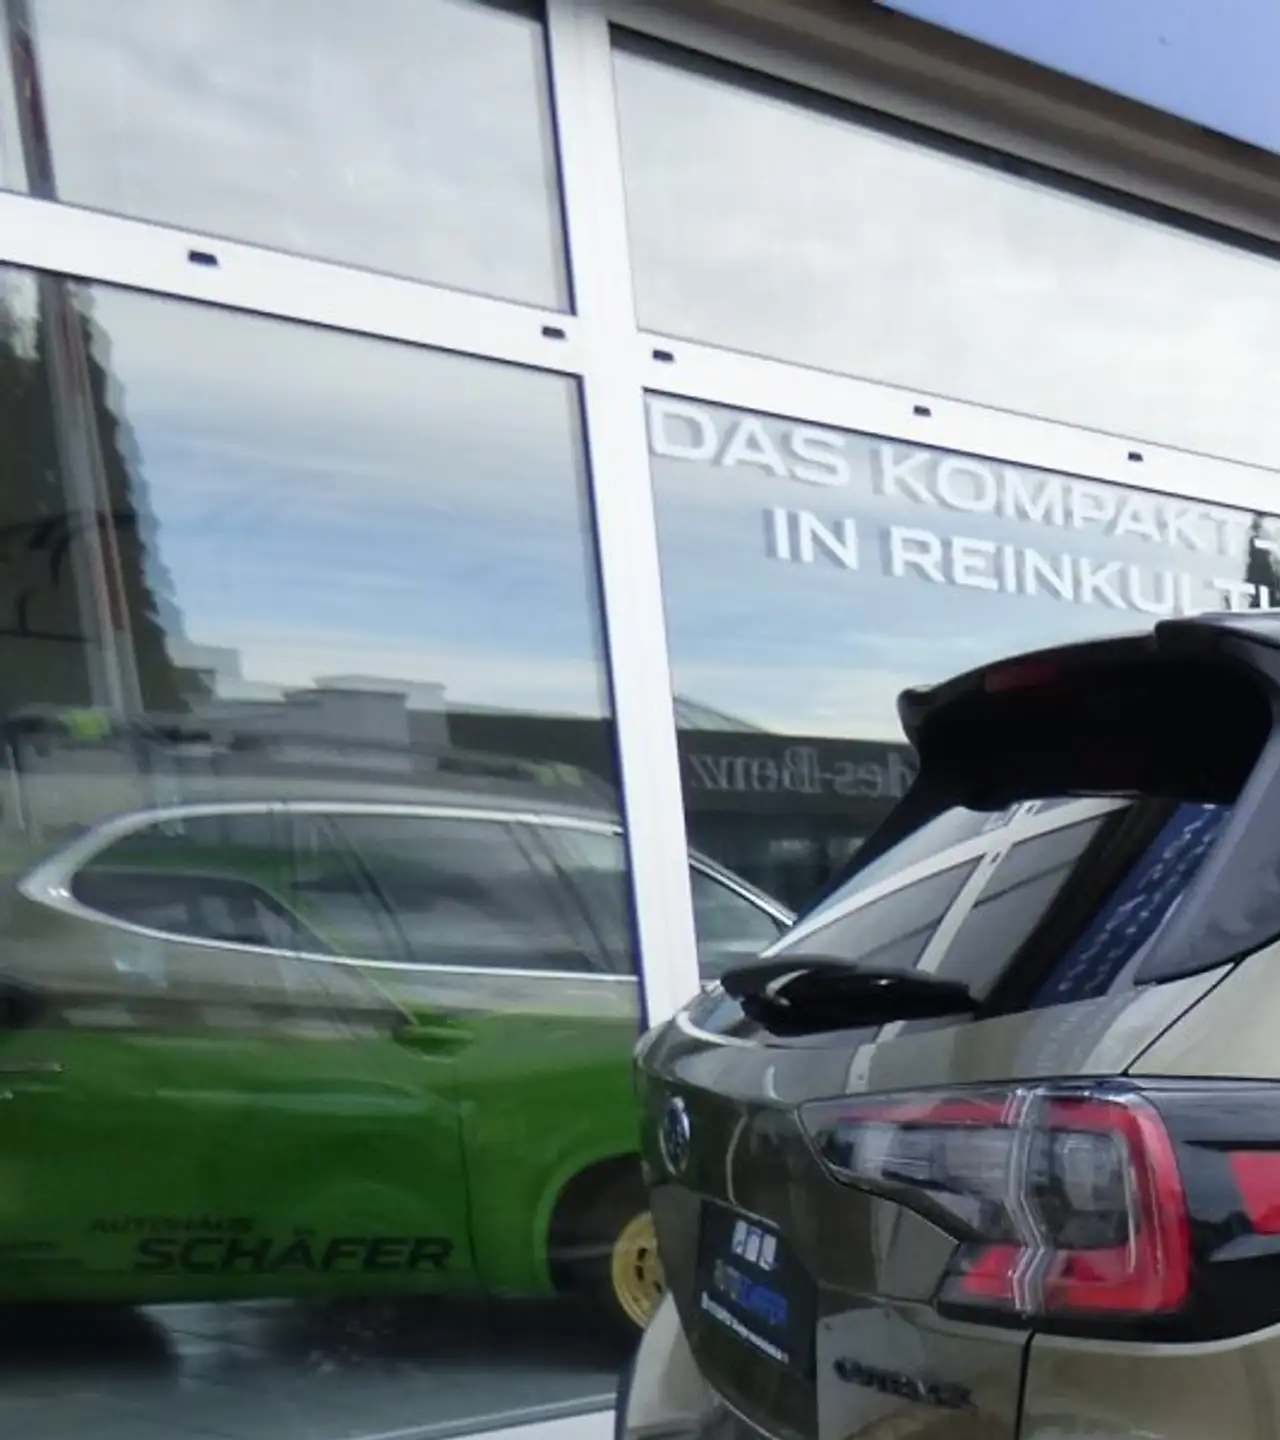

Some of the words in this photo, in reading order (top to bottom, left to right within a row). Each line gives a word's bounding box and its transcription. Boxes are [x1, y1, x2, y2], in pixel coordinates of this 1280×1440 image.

[651, 401, 852, 489] DAS
[768, 506, 859, 573] IN
[134, 1229, 456, 1273] SCHÄFER
